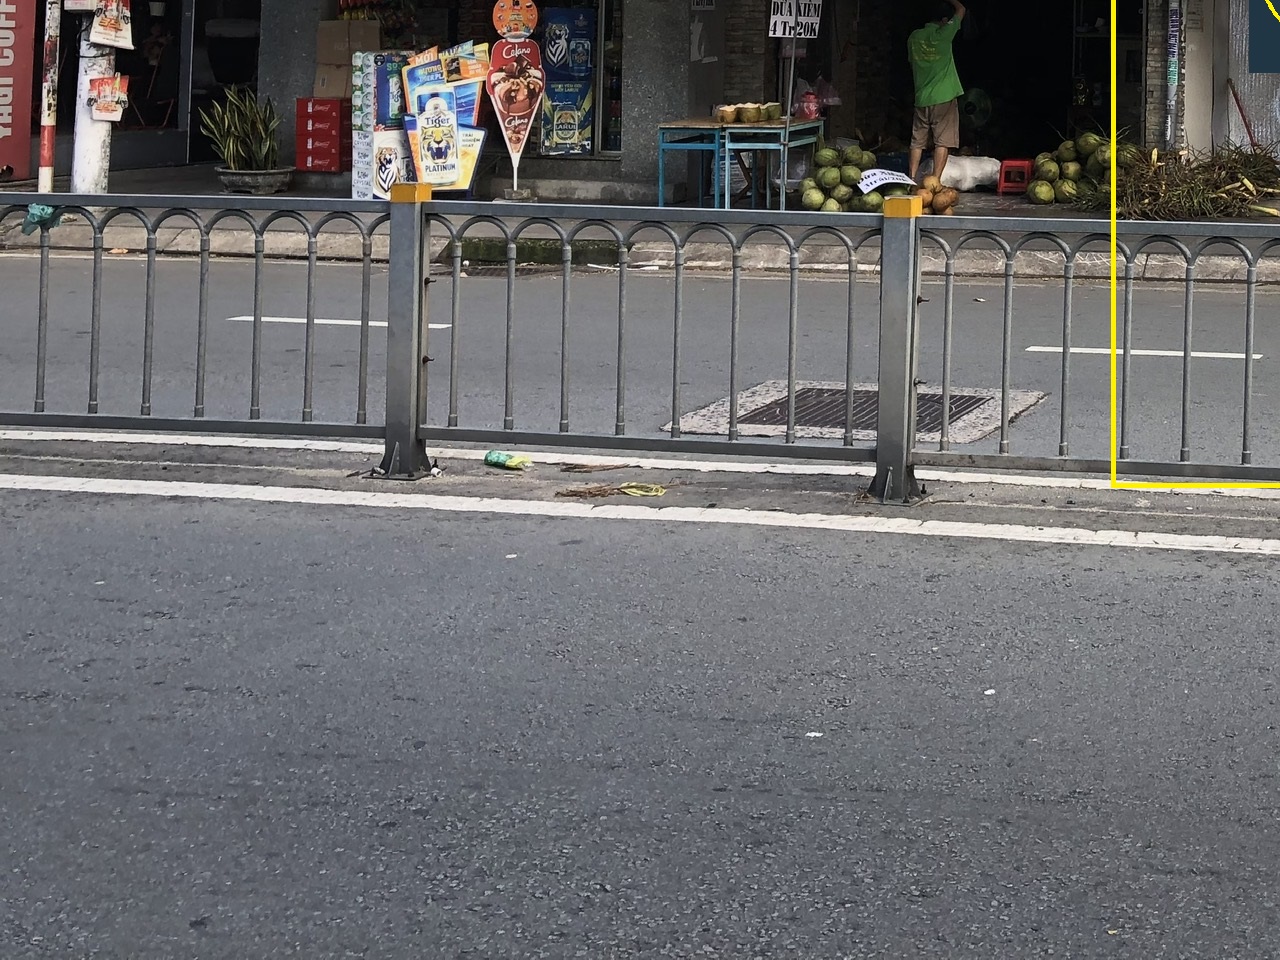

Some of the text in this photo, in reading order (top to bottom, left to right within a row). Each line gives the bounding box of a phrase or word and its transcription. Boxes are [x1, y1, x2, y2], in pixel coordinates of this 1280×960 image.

[770, 20, 777, 35] 4
[424, 114, 450, 128] Tiger
[425, 163, 456, 173] PLATINUM
